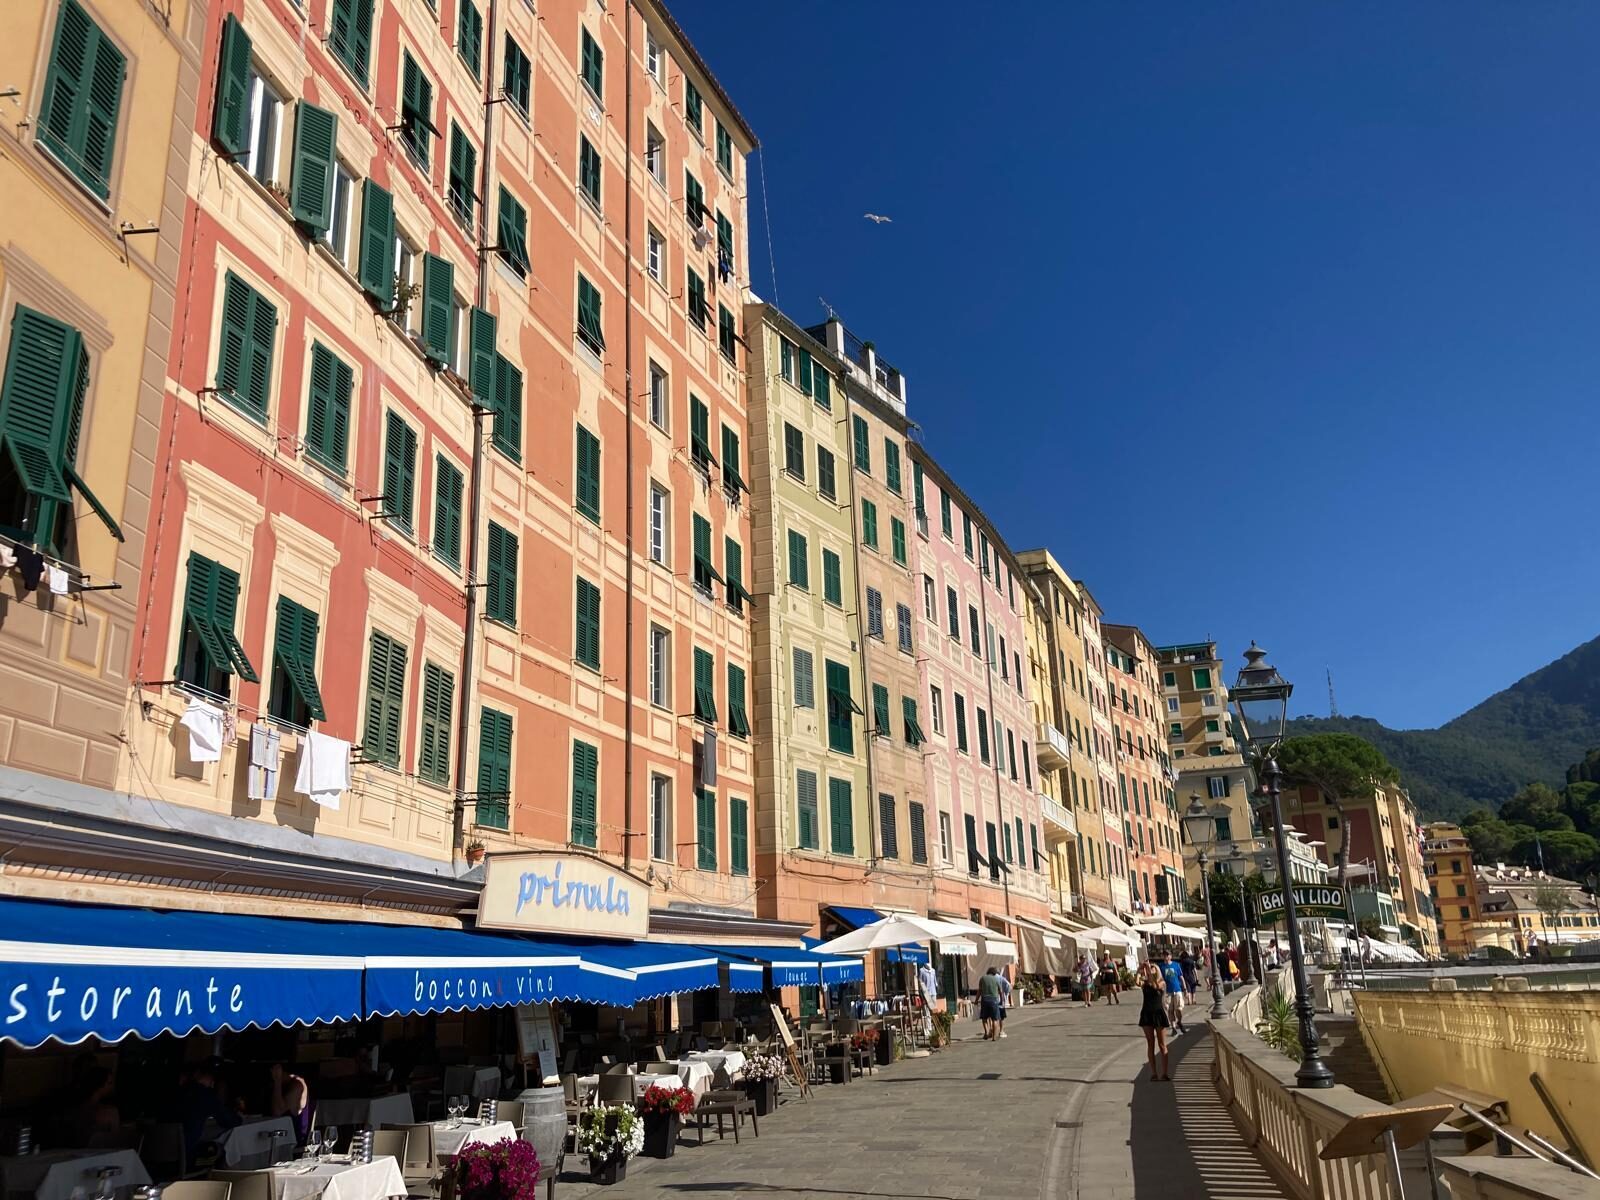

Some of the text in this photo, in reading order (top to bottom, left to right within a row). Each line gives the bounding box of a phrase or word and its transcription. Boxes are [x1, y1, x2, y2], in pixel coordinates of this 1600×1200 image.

[515, 860, 631, 918] primula
[1309, 888, 1342, 906] LIDO
[516, 968, 553, 995] vino
[839, 966, 850, 979] bar
[6, 976, 244, 1025] storante
